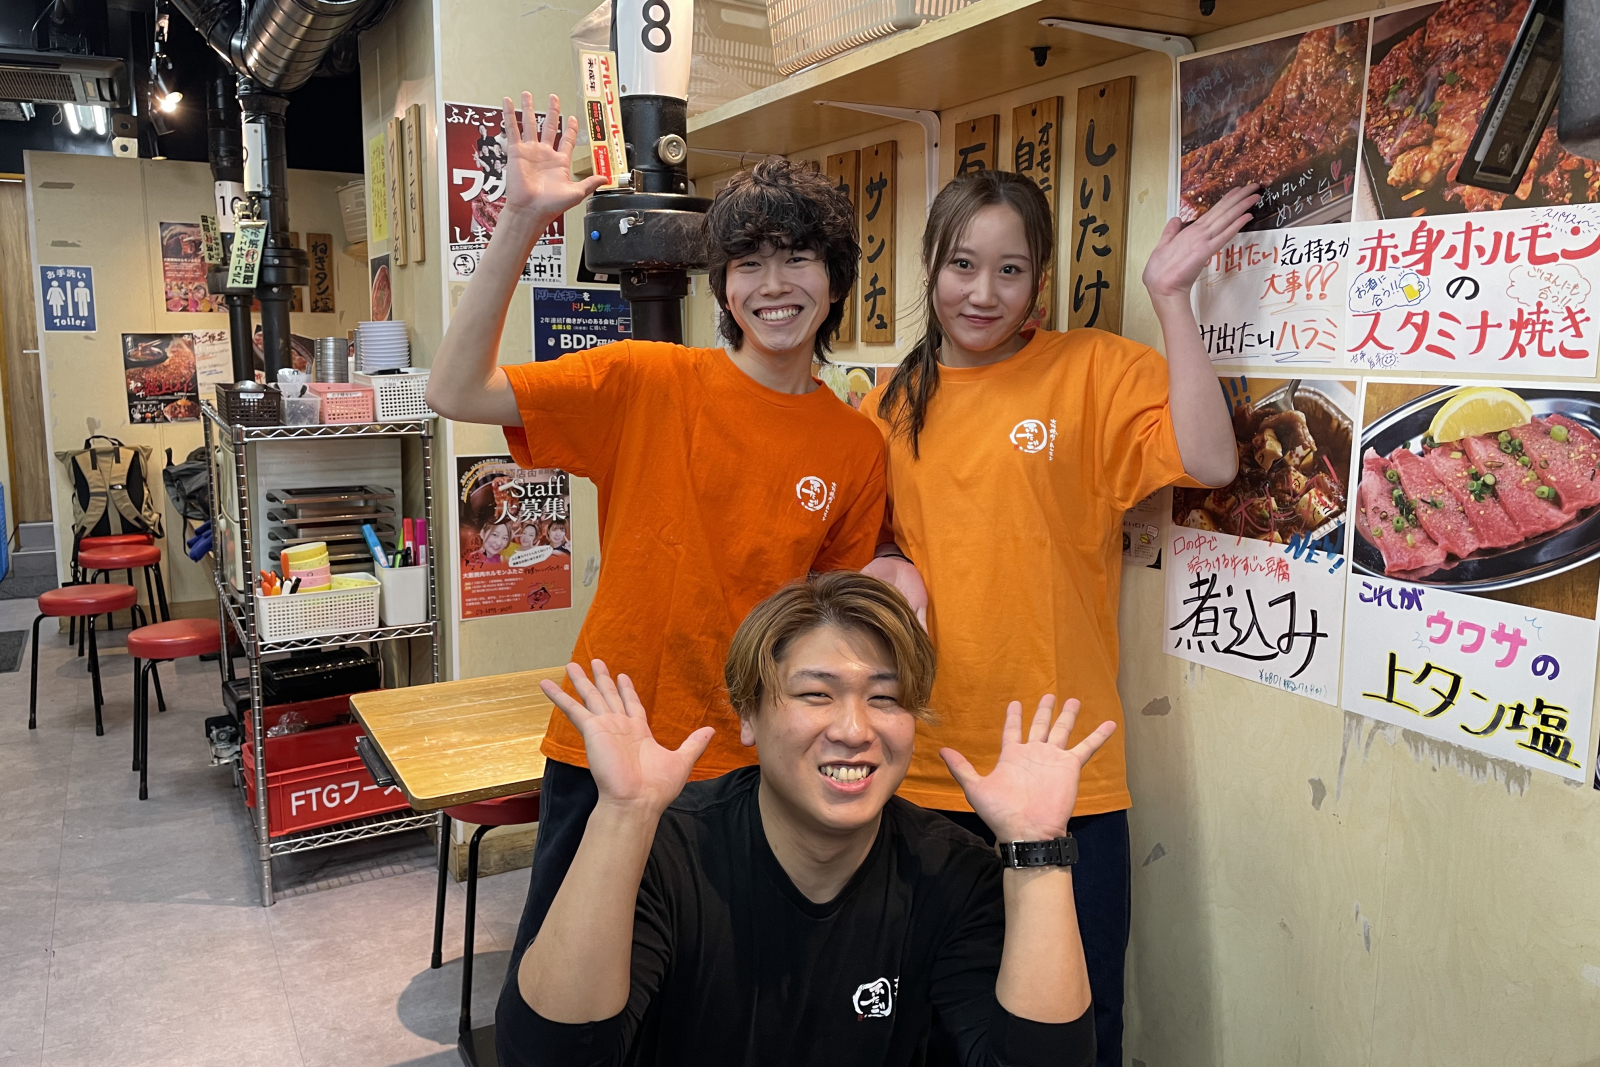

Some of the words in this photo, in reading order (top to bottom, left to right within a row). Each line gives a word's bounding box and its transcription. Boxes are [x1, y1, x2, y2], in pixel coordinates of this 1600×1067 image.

[641, 0, 672, 53] 8
[453, 168, 507, 202] ワク
[1073, 118, 1118, 328] しいたけ
[864, 171, 888, 330] サンチュ
[1356, 220, 1600, 277] 赤身ホルモン
[46, 268, 87, 280] お手洗い
[311, 241, 334, 312] ねぎタン塩
[1355, 275, 1387, 299] お酒に
[1445, 275, 1480, 301] の
[1527, 266, 1580, 296] ごはんにも
[535, 289, 591, 302] ドリームキラーを
[572, 302, 631, 313] ドリームサポーター
[1372, 280, 1399, 307] 合う!!
[53, 317, 87, 328] Toilet
[1348, 301, 1591, 361] スタミナ焼き
[510, 475, 566, 498] Staff
[1173, 533, 1218, 556] 口の中で
[1284, 521, 1345, 575] NEW!
[1358, 580, 1424, 612] これが
[1169, 571, 1329, 679] 煮込み
[1425, 609, 1561, 681] ウワサの
[1362, 651, 1582, 769] 上タン塩
